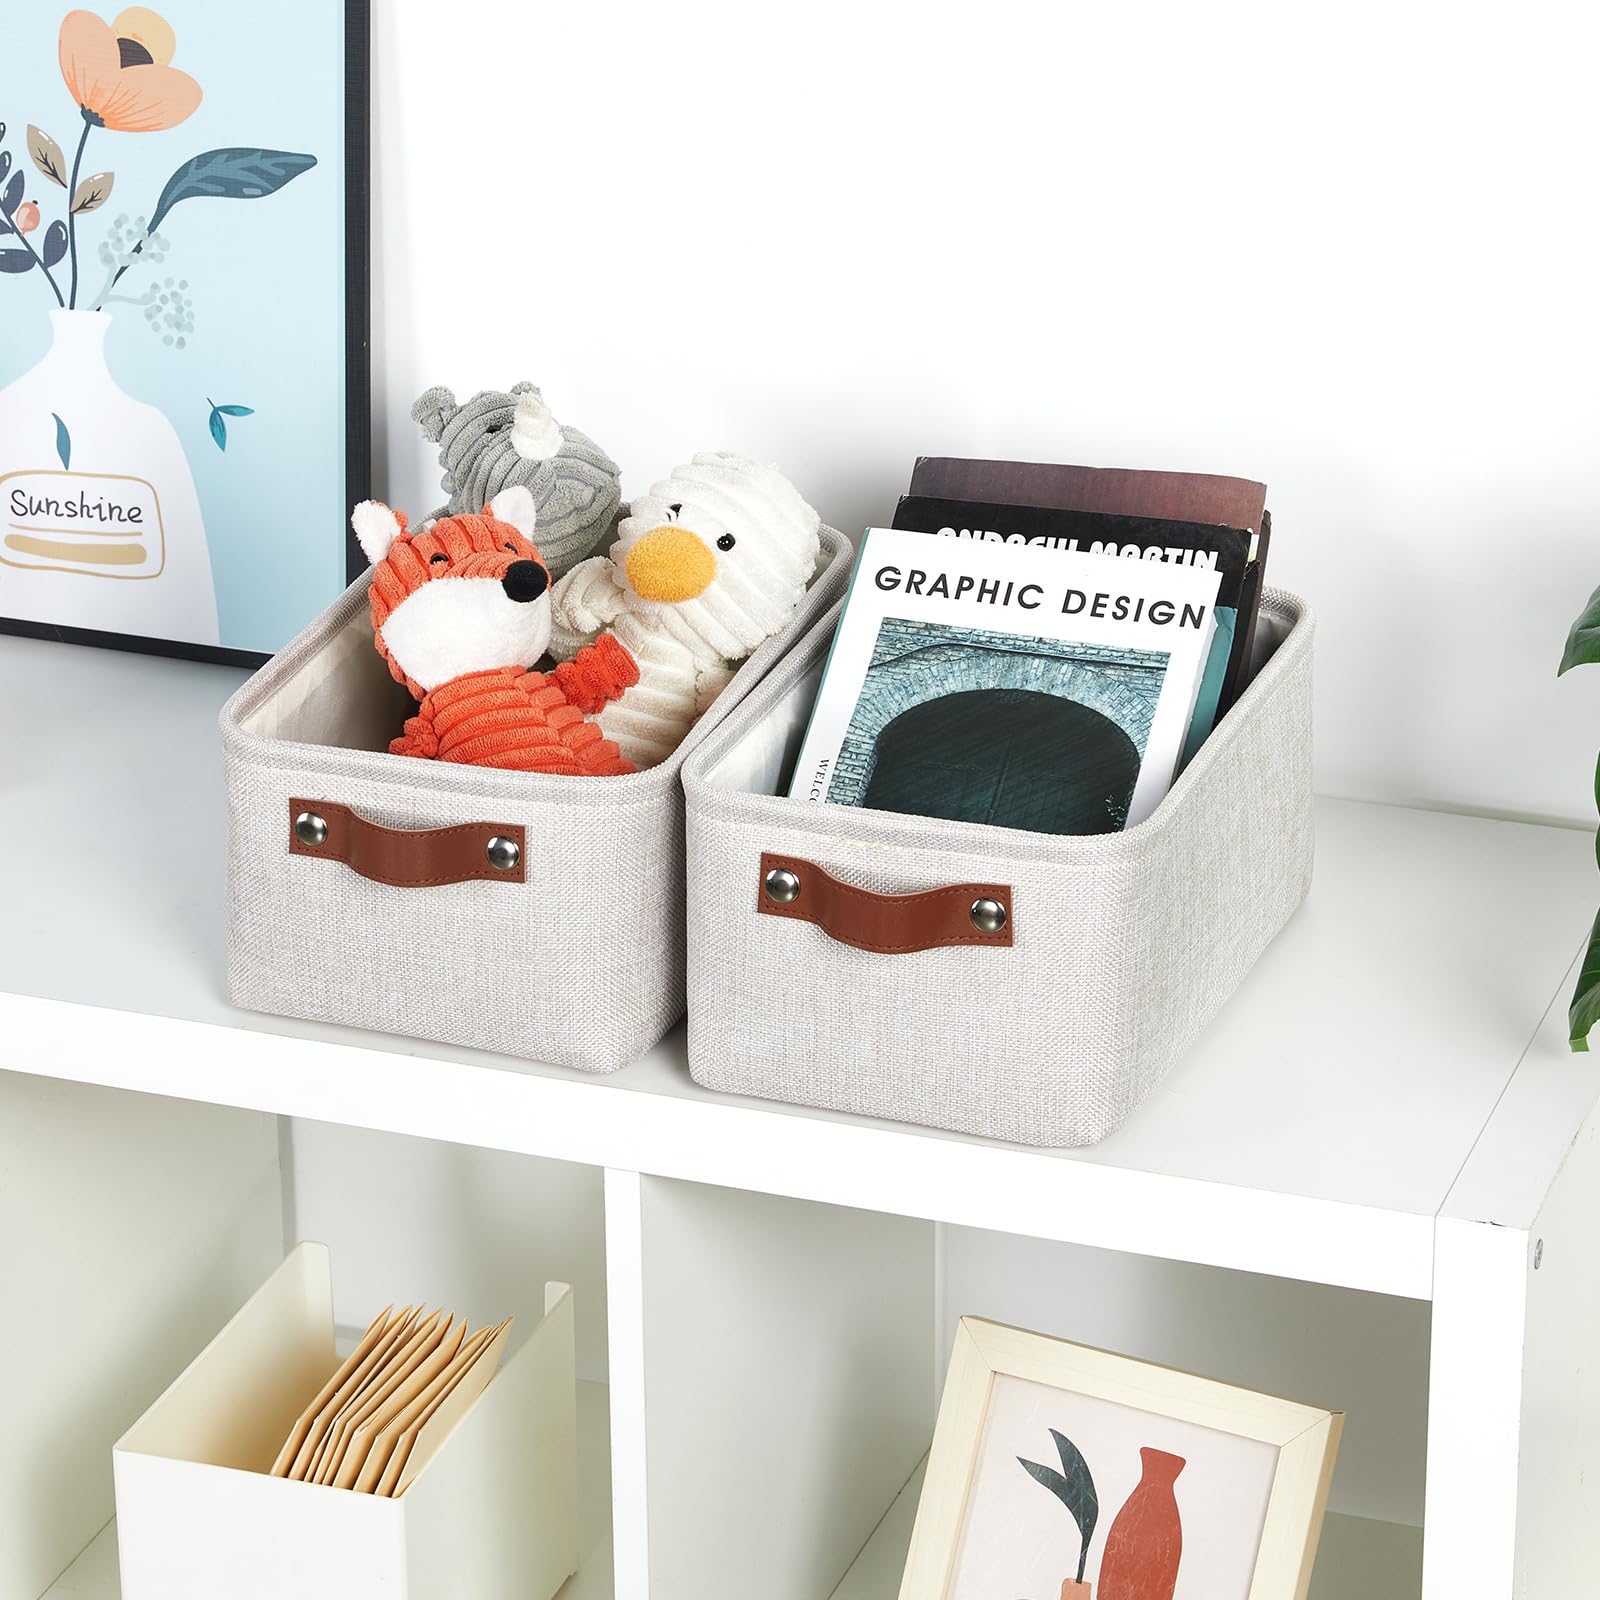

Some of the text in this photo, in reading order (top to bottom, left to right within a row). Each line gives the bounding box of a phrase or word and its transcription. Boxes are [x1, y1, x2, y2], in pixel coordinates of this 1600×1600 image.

[10, 489, 143, 523] Sunshine
[874, 565, 1206, 629] GRAPHIC DESIGN
[809, 759, 830, 801] WELC
